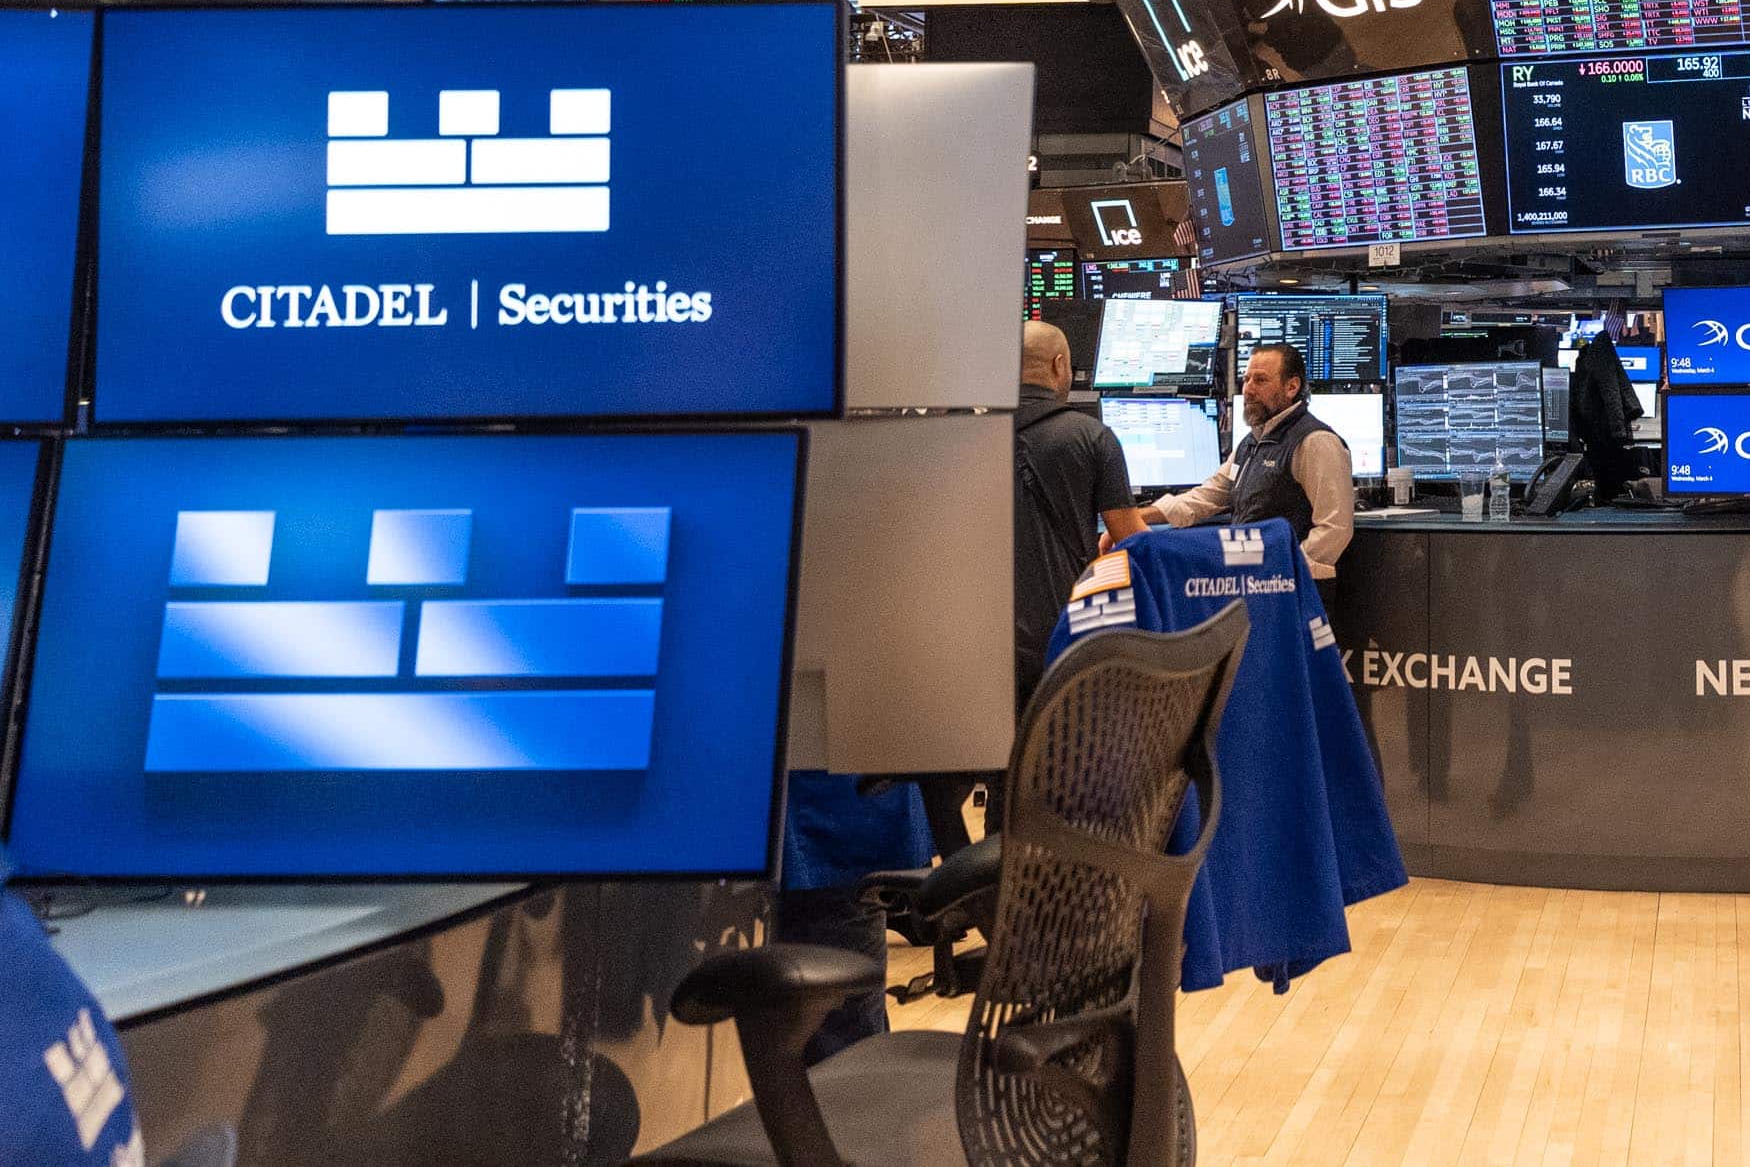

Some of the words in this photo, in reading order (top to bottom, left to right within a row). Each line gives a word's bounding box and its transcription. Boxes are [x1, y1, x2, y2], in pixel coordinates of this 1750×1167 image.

[1512, 66, 1534, 82] RY
[1588, 60, 1644, 75] 166.0000
[1676, 56, 1719, 72] 165.92
[1702, 67, 1719, 78] 400
[1533, 94, 1561, 105] 33,790
[1534, 117, 1563, 127] 166.64
[1535, 140, 1564, 151] 167.67
[1537, 164, 1565, 174] 165.94
[1631, 168, 1671, 184] RBC
[1538, 187, 1567, 197] 166.34
[1374, 245, 1394, 257] 1012
[220, 283, 448, 329] CITADEL
[497, 281, 712, 327] Securities
[1671, 357, 1691, 368] 9:48
[1671, 465, 1691, 475] 9:48
[1185, 576, 1240, 598] CITADEL
[1247, 574, 1296, 595] Securities
[1363, 649, 1573, 695] EXCHANGE
